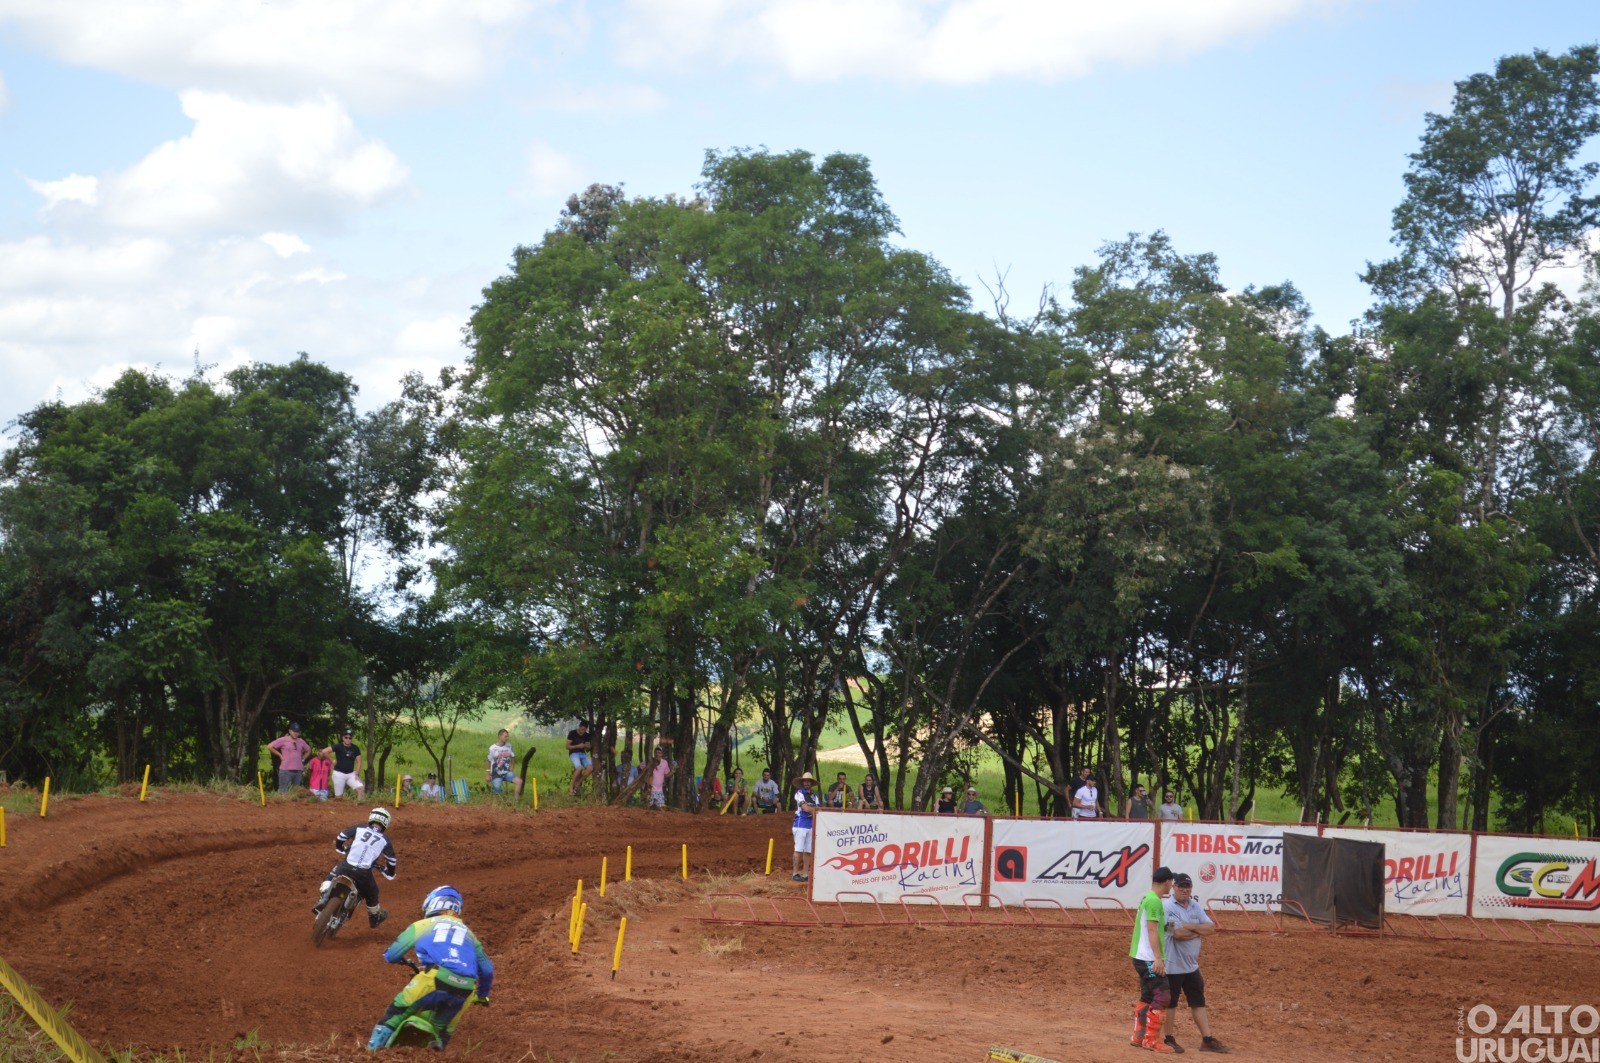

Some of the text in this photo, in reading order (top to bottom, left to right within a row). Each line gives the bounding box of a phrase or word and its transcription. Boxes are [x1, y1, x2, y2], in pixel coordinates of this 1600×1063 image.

[360, 831, 381, 846] 97
[827, 829, 849, 837] NOSSA
[849, 824, 874, 835] VIDA
[837, 833, 888, 847] OFF ROAD!
[1172, 833, 1283, 855] RIBAS Mot
[838, 835, 970, 875] BORILLI
[1035, 843, 1149, 888] AMX
[1385, 851, 1458, 885] ORILLI
[876, 858, 976, 891] Racing
[1220, 864, 1278, 882] YAMAHA
[1496, 852, 1600, 904] CCM
[1388, 872, 1462, 903] Racing
[432, 922, 467, 946] 11
